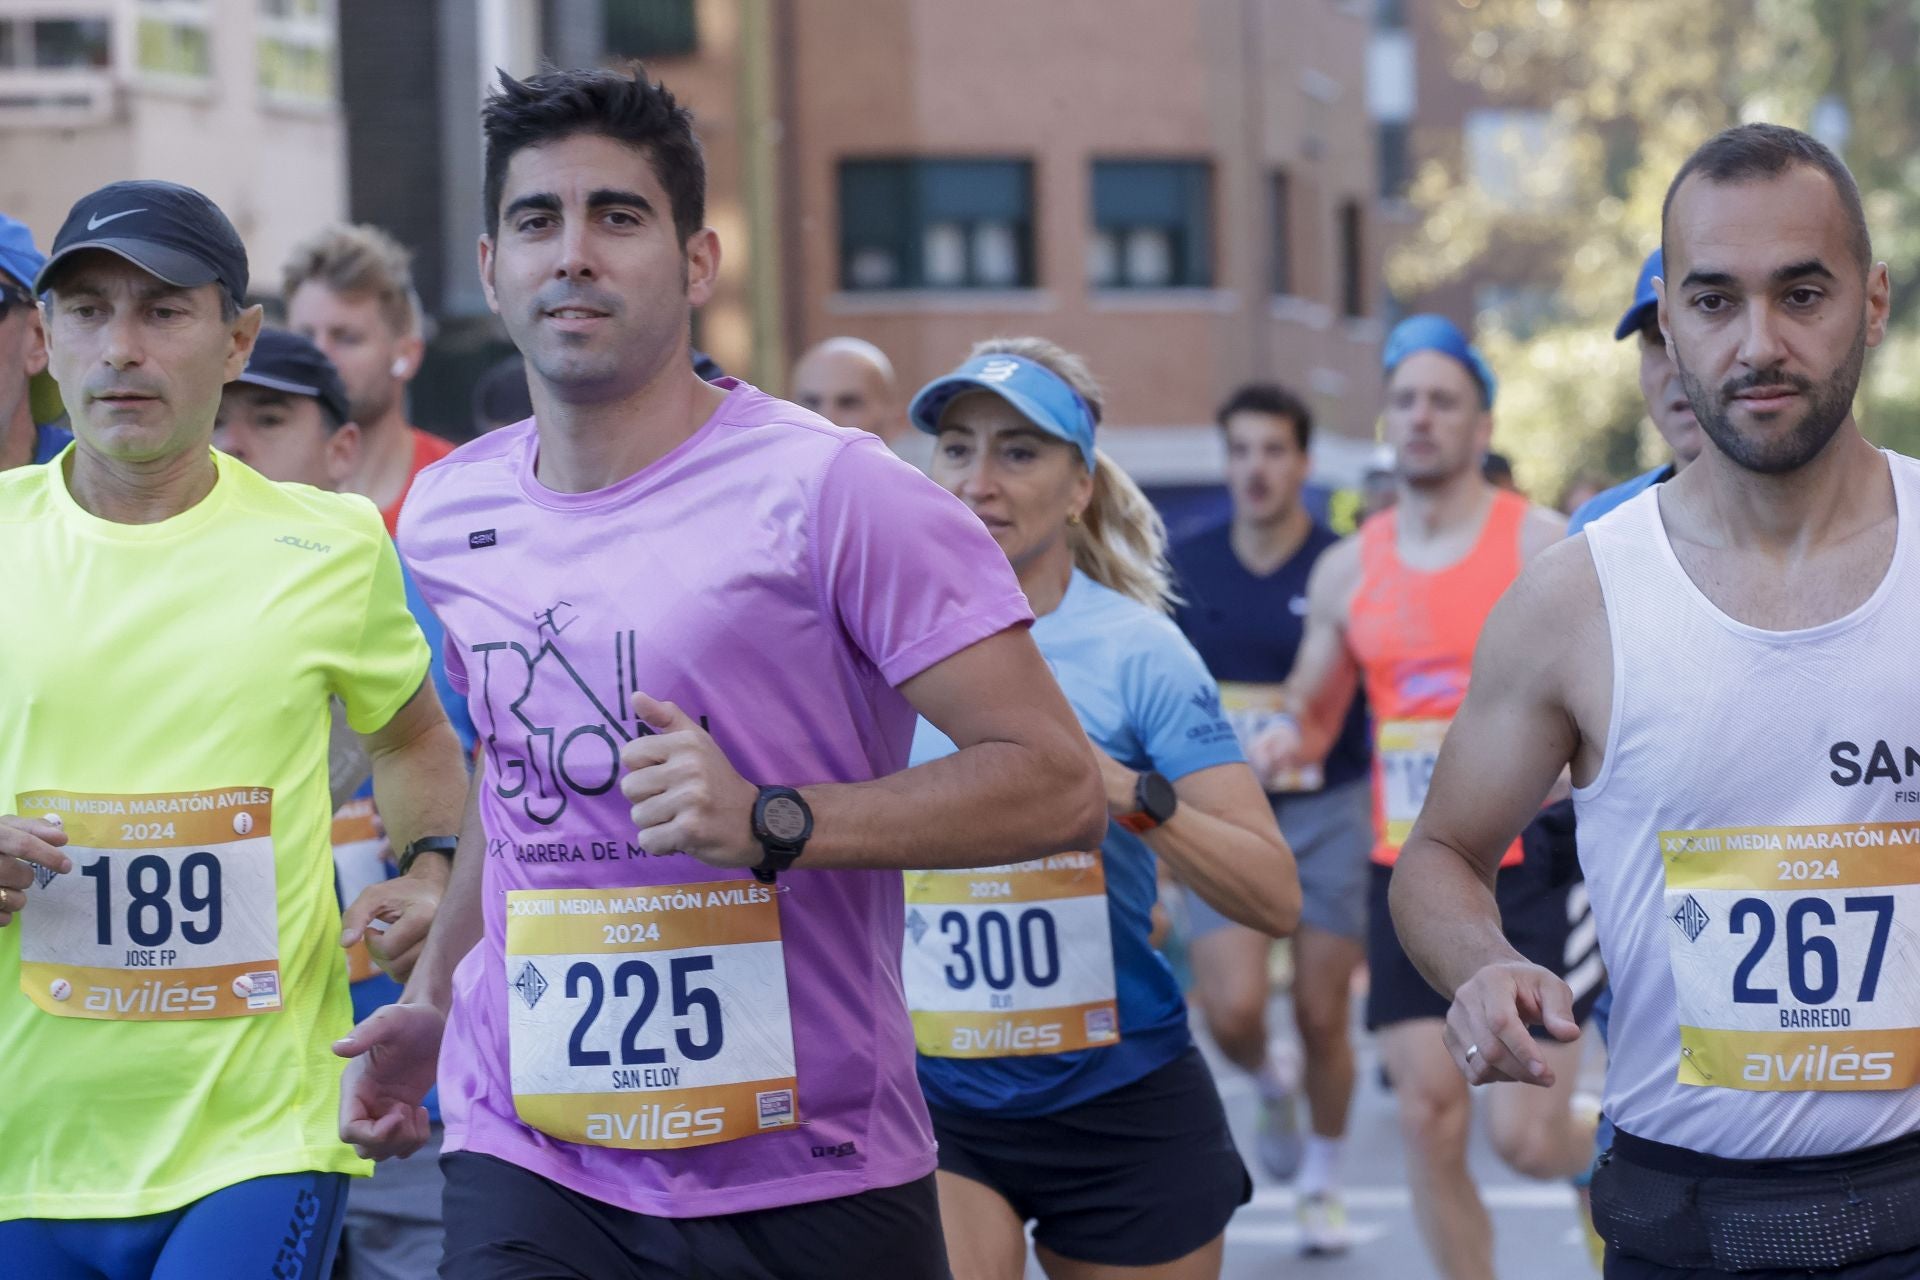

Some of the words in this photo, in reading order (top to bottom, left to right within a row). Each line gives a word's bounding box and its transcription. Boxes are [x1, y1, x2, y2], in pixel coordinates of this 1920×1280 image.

[23, 796, 71, 811] XXXIII
[75, 800, 125, 815] MEDIA
[130, 794, 215, 815] MARATÓN
[217, 787, 269, 807] AVILÉS
[121, 822, 176, 841] 2024
[1664, 837, 1721, 853] XXXIII
[1726, 836, 1782, 851] MEDIA
[1786, 826, 1885, 849] MARATÓN
[591, 841, 617, 861] DE
[1777, 860, 1840, 880] 2024
[81, 851, 222, 947] 189
[511, 899, 554, 916] XXXIII
[559, 899, 605, 915] MEDIA
[610, 890, 703, 915] MARATÓN
[706, 884, 771, 907] AVILÉS
[970, 881, 1012, 898] 2024
[603, 922, 660, 944] 2024
[125, 951, 155, 967] JOSE
[161, 951, 176, 967] FP
[939, 908, 1060, 991] 300
[1729, 895, 1896, 1006] 267
[85, 980, 218, 1013] avilés
[565, 954, 724, 1067] 225
[1780, 1008, 1851, 1028] BARREDO
[951, 1019, 1063, 1051] avilés
[1743, 1045, 1895, 1082] avilés
[612, 1069, 640, 1089] SAN
[645, 1067, 681, 1088] ELOY
[586, 1103, 725, 1141] avilés
